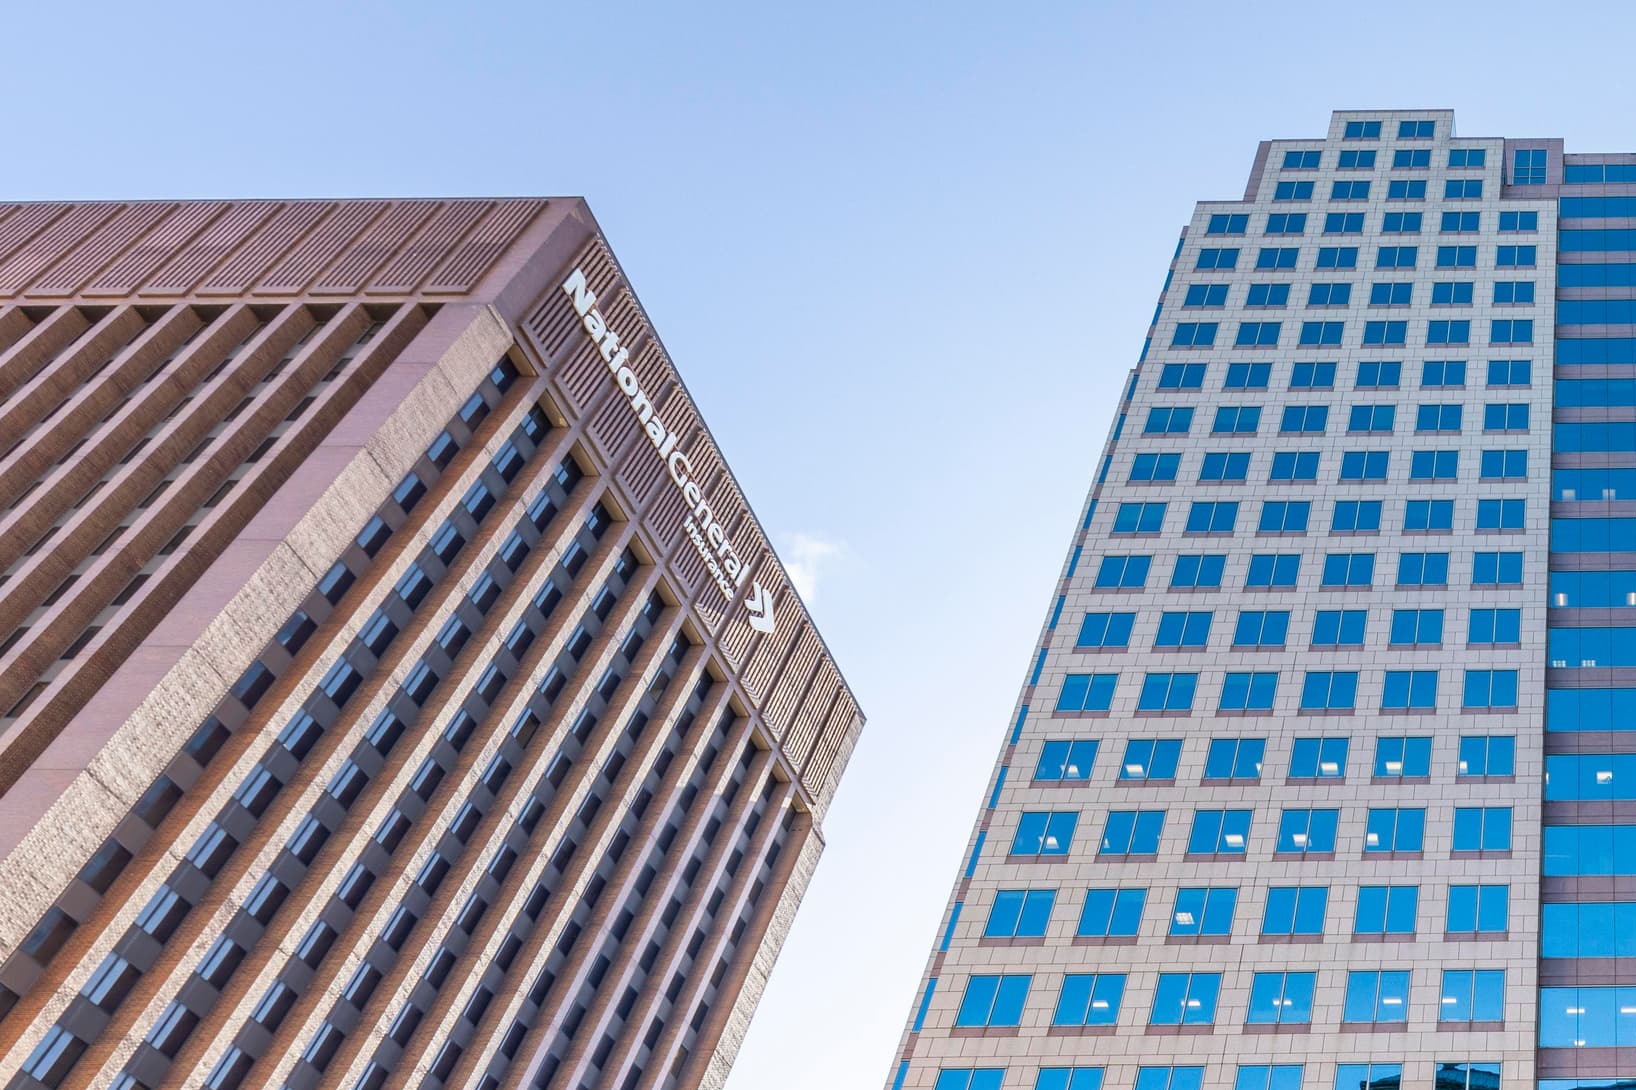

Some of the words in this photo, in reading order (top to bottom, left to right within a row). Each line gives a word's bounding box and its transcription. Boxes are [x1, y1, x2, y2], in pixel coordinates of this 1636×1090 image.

[562, 268, 677, 460] National
[668, 451, 750, 587] General
[683, 516, 734, 601] Insurance
